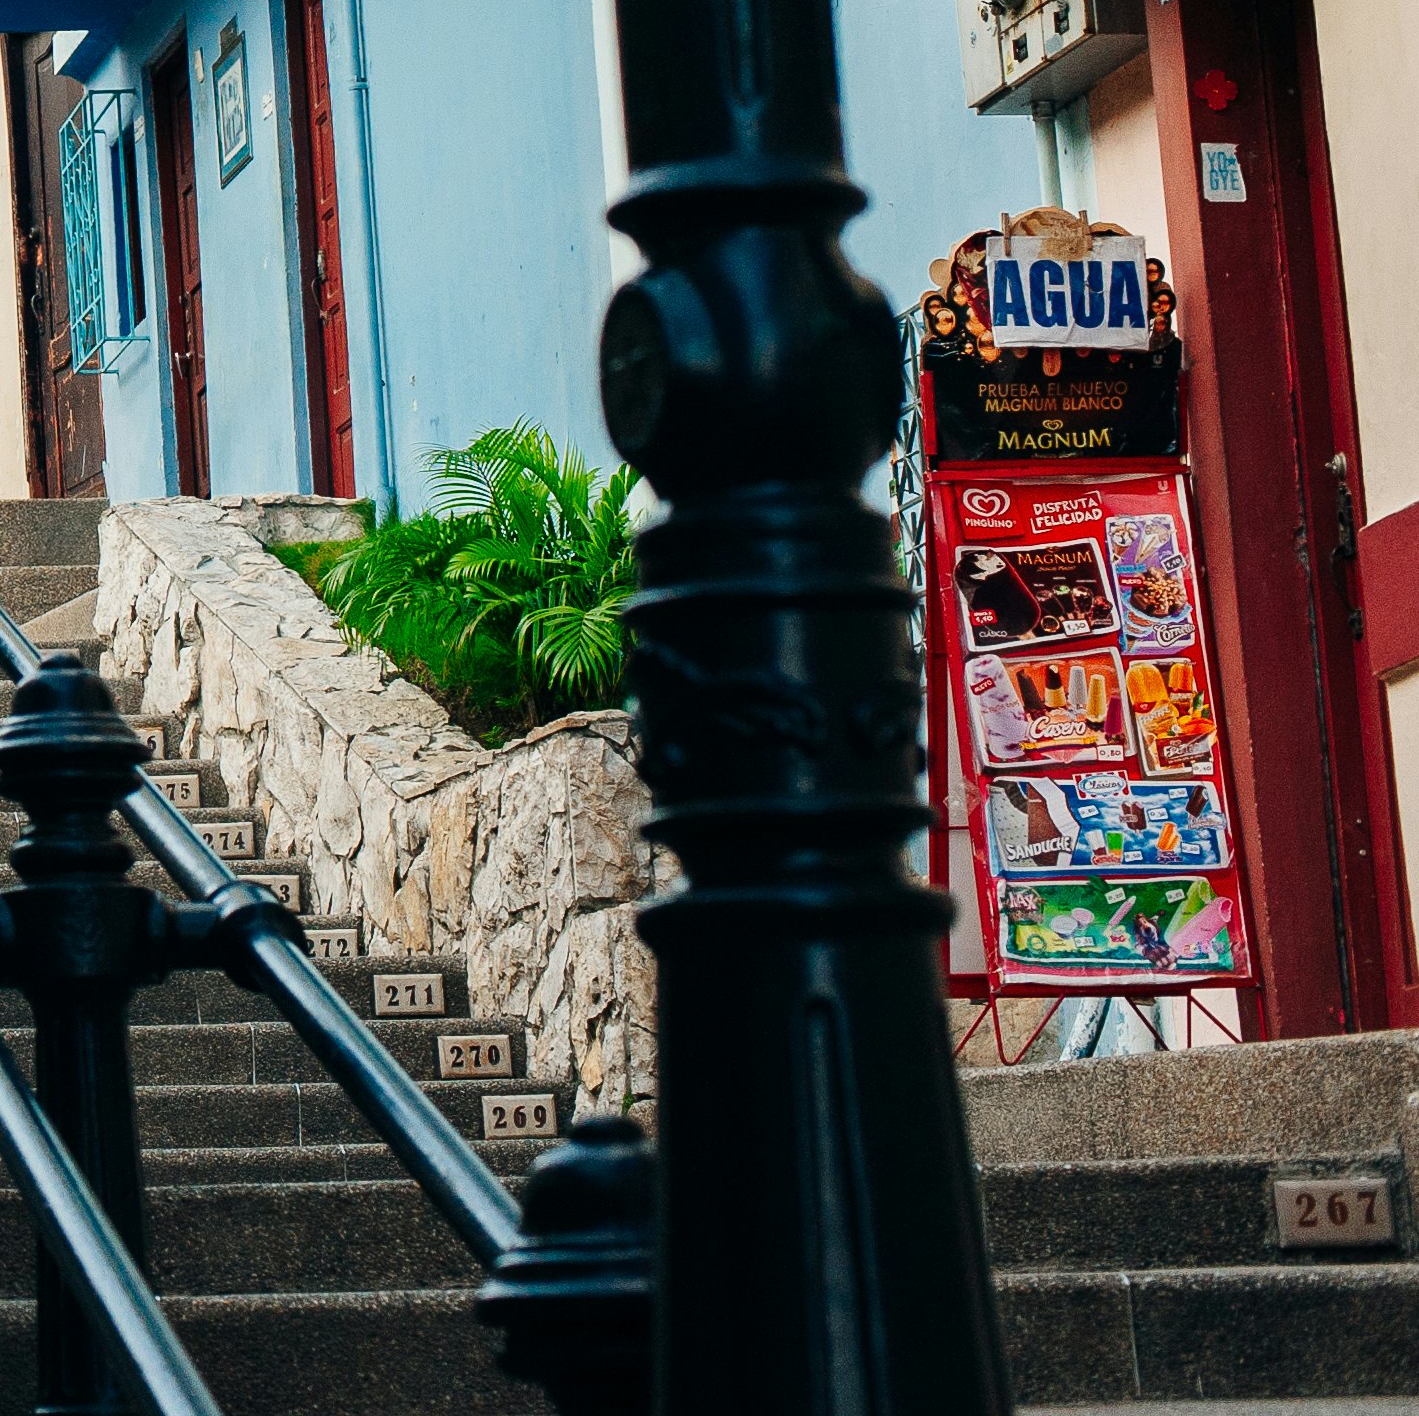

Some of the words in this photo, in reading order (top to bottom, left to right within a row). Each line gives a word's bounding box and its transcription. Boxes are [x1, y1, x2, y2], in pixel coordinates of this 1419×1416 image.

[992, 259, 1146, 329] AGUA
[978, 383, 1040, 398] PRUEBA
[1047, 382, 1062, 397] EL
[1069, 381, 1128, 397] NUEVO
[985, 397, 1057, 413] MAGNUM
[1063, 396, 1123, 411] BLANCO
[997, 427, 1111, 450] MAGNUM
[1032, 496, 1099, 516] DISFRUTA
[1035, 508, 1103, 528] FELICIDAD
[1017, 550, 1093, 565] MAGNUM
[1029, 716, 1087, 739] Casero
[1005, 836, 1071, 861] SANDUCHE
[385, 984, 435, 1006] 271
[449, 1044, 501, 1067] 270
[492, 1105, 547, 1130] 269
[1294, 1191, 1378, 1228] 267
